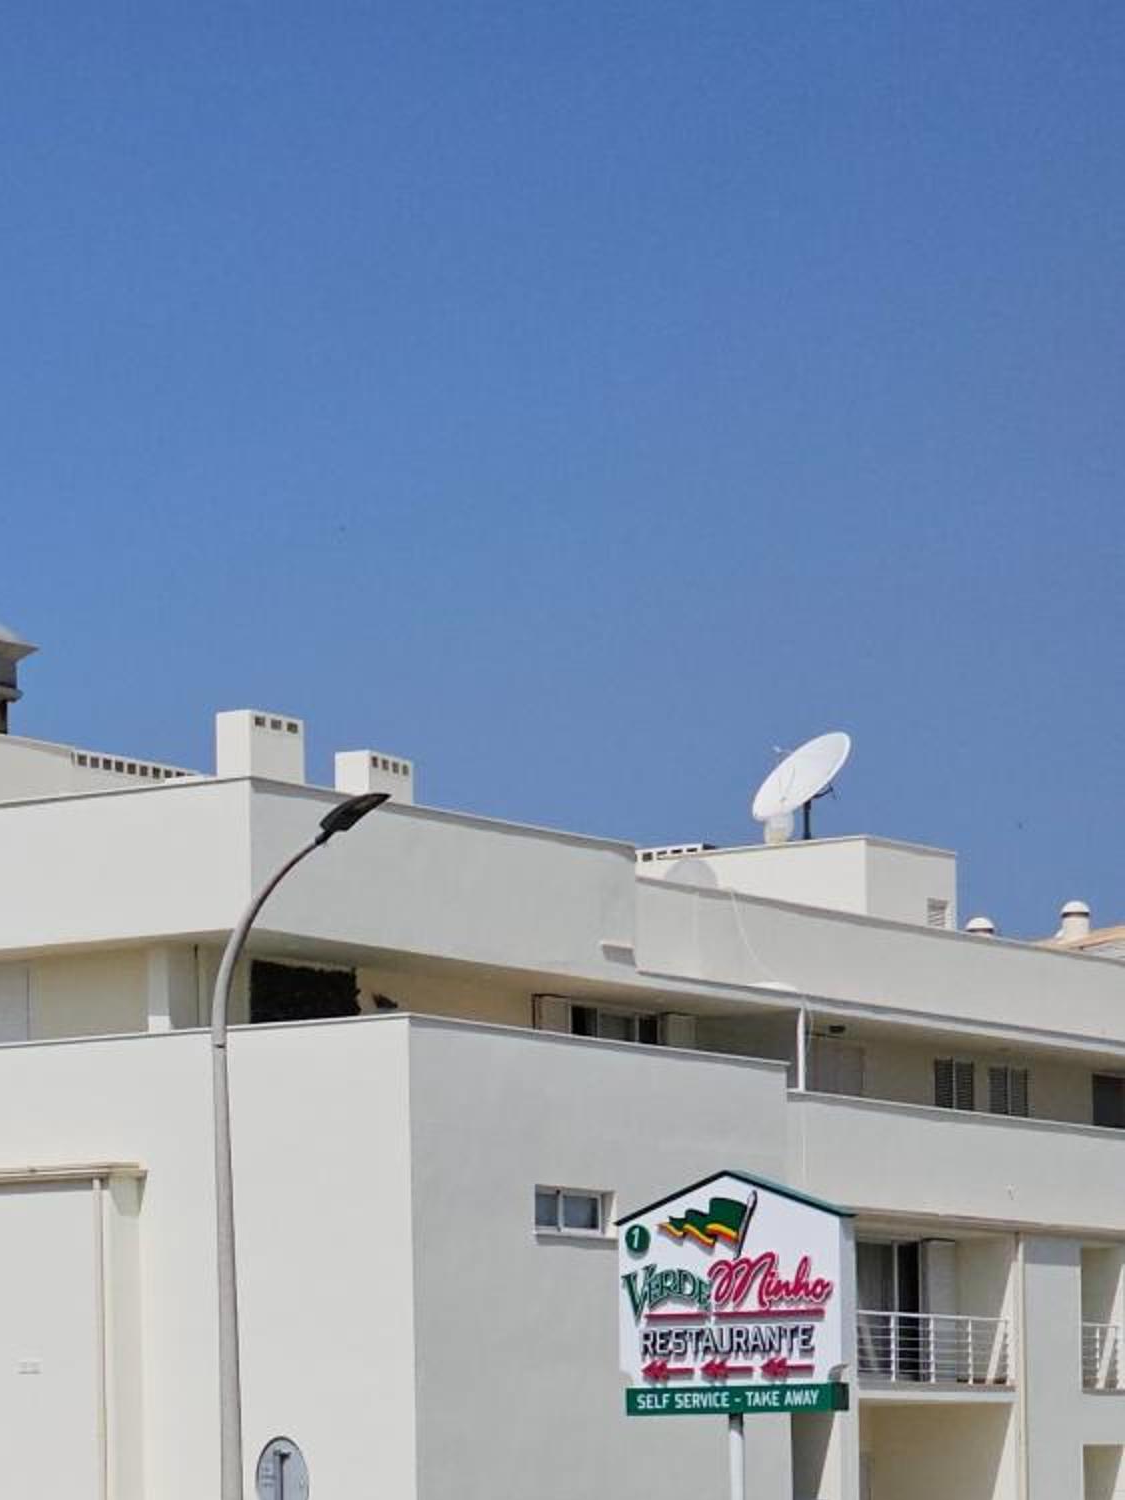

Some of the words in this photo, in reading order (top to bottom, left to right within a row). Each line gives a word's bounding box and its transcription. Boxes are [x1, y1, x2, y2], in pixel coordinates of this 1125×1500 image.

[708, 1251, 833, 1309] Minho
[641, 1325, 815, 1358] RESTAURANTE
[636, 1394, 670, 1409] SELF
[674, 1392, 730, 1408] SERVICE
[745, 1391, 780, 1407] TAKE
[784, 1389, 820, 1406] AWAY
